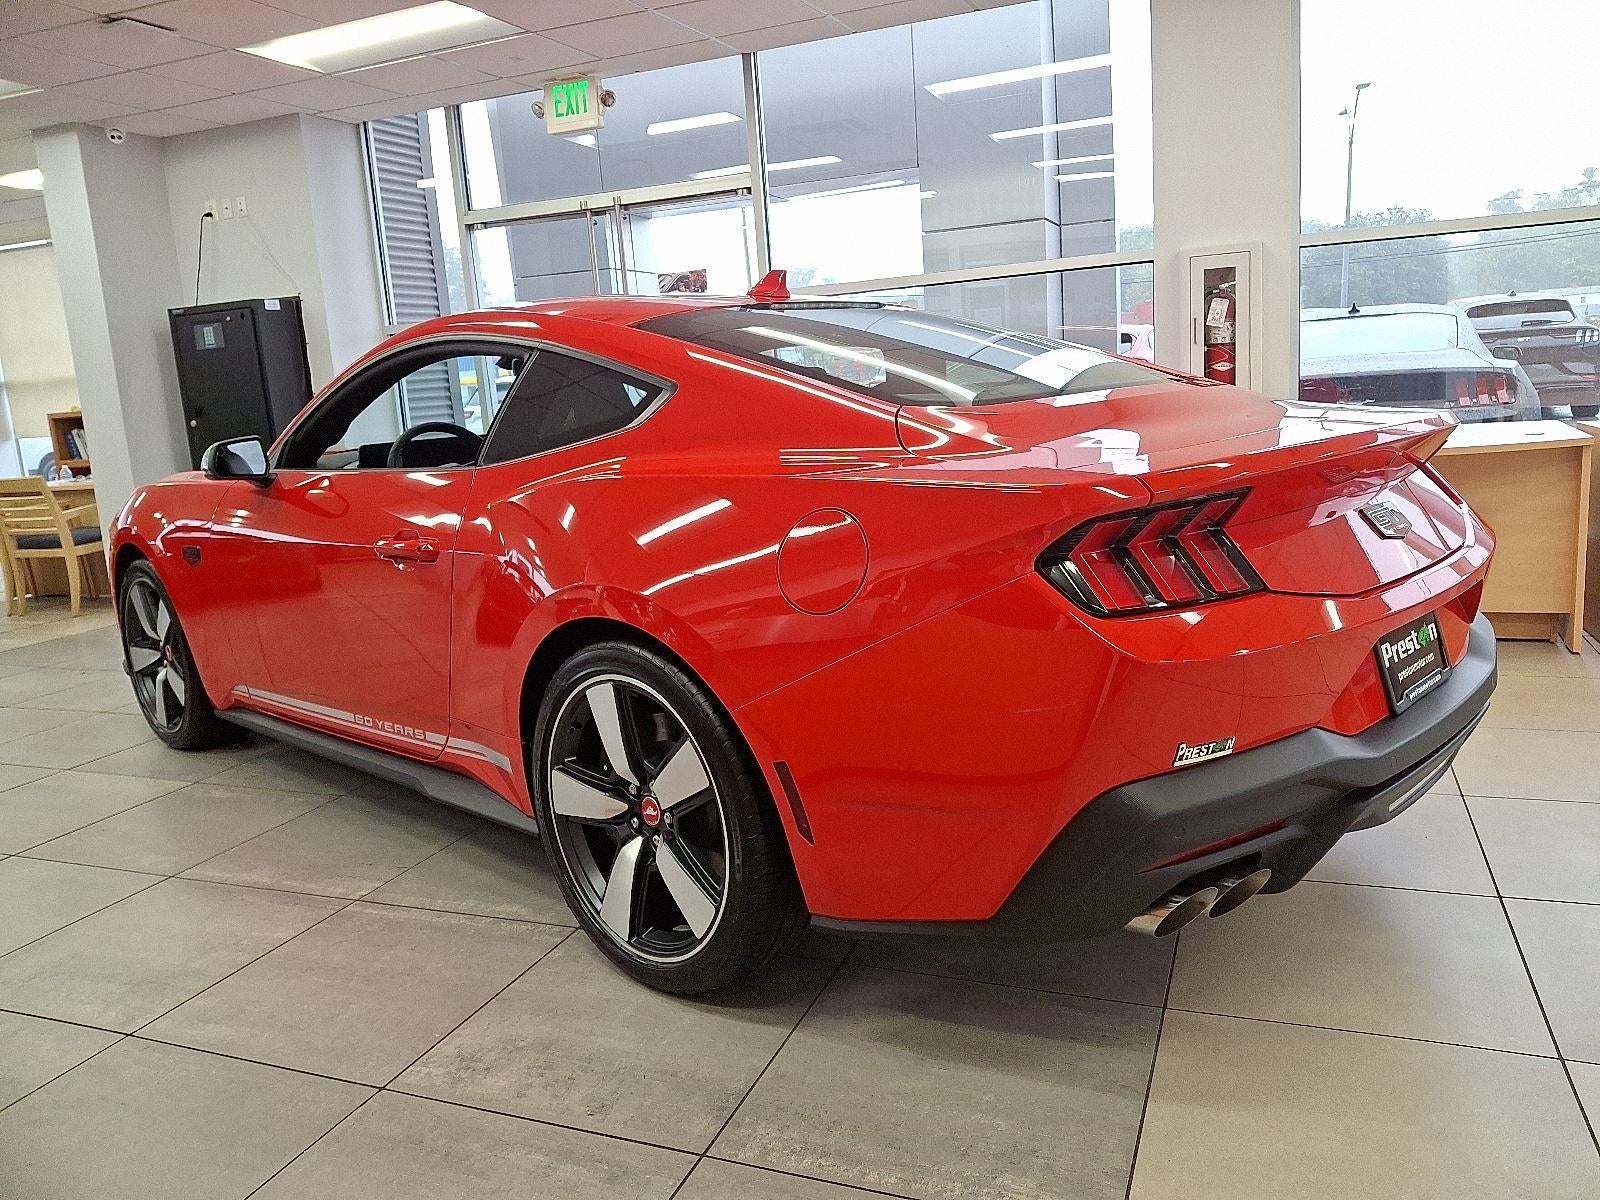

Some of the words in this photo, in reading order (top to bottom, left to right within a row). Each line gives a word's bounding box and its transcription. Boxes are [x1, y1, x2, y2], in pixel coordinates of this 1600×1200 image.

[553, 81, 588, 117] EXIT
[1380, 622, 1438, 669] Preston
[355, 714, 373, 727] 60
[376, 719, 425, 740] YEARS
